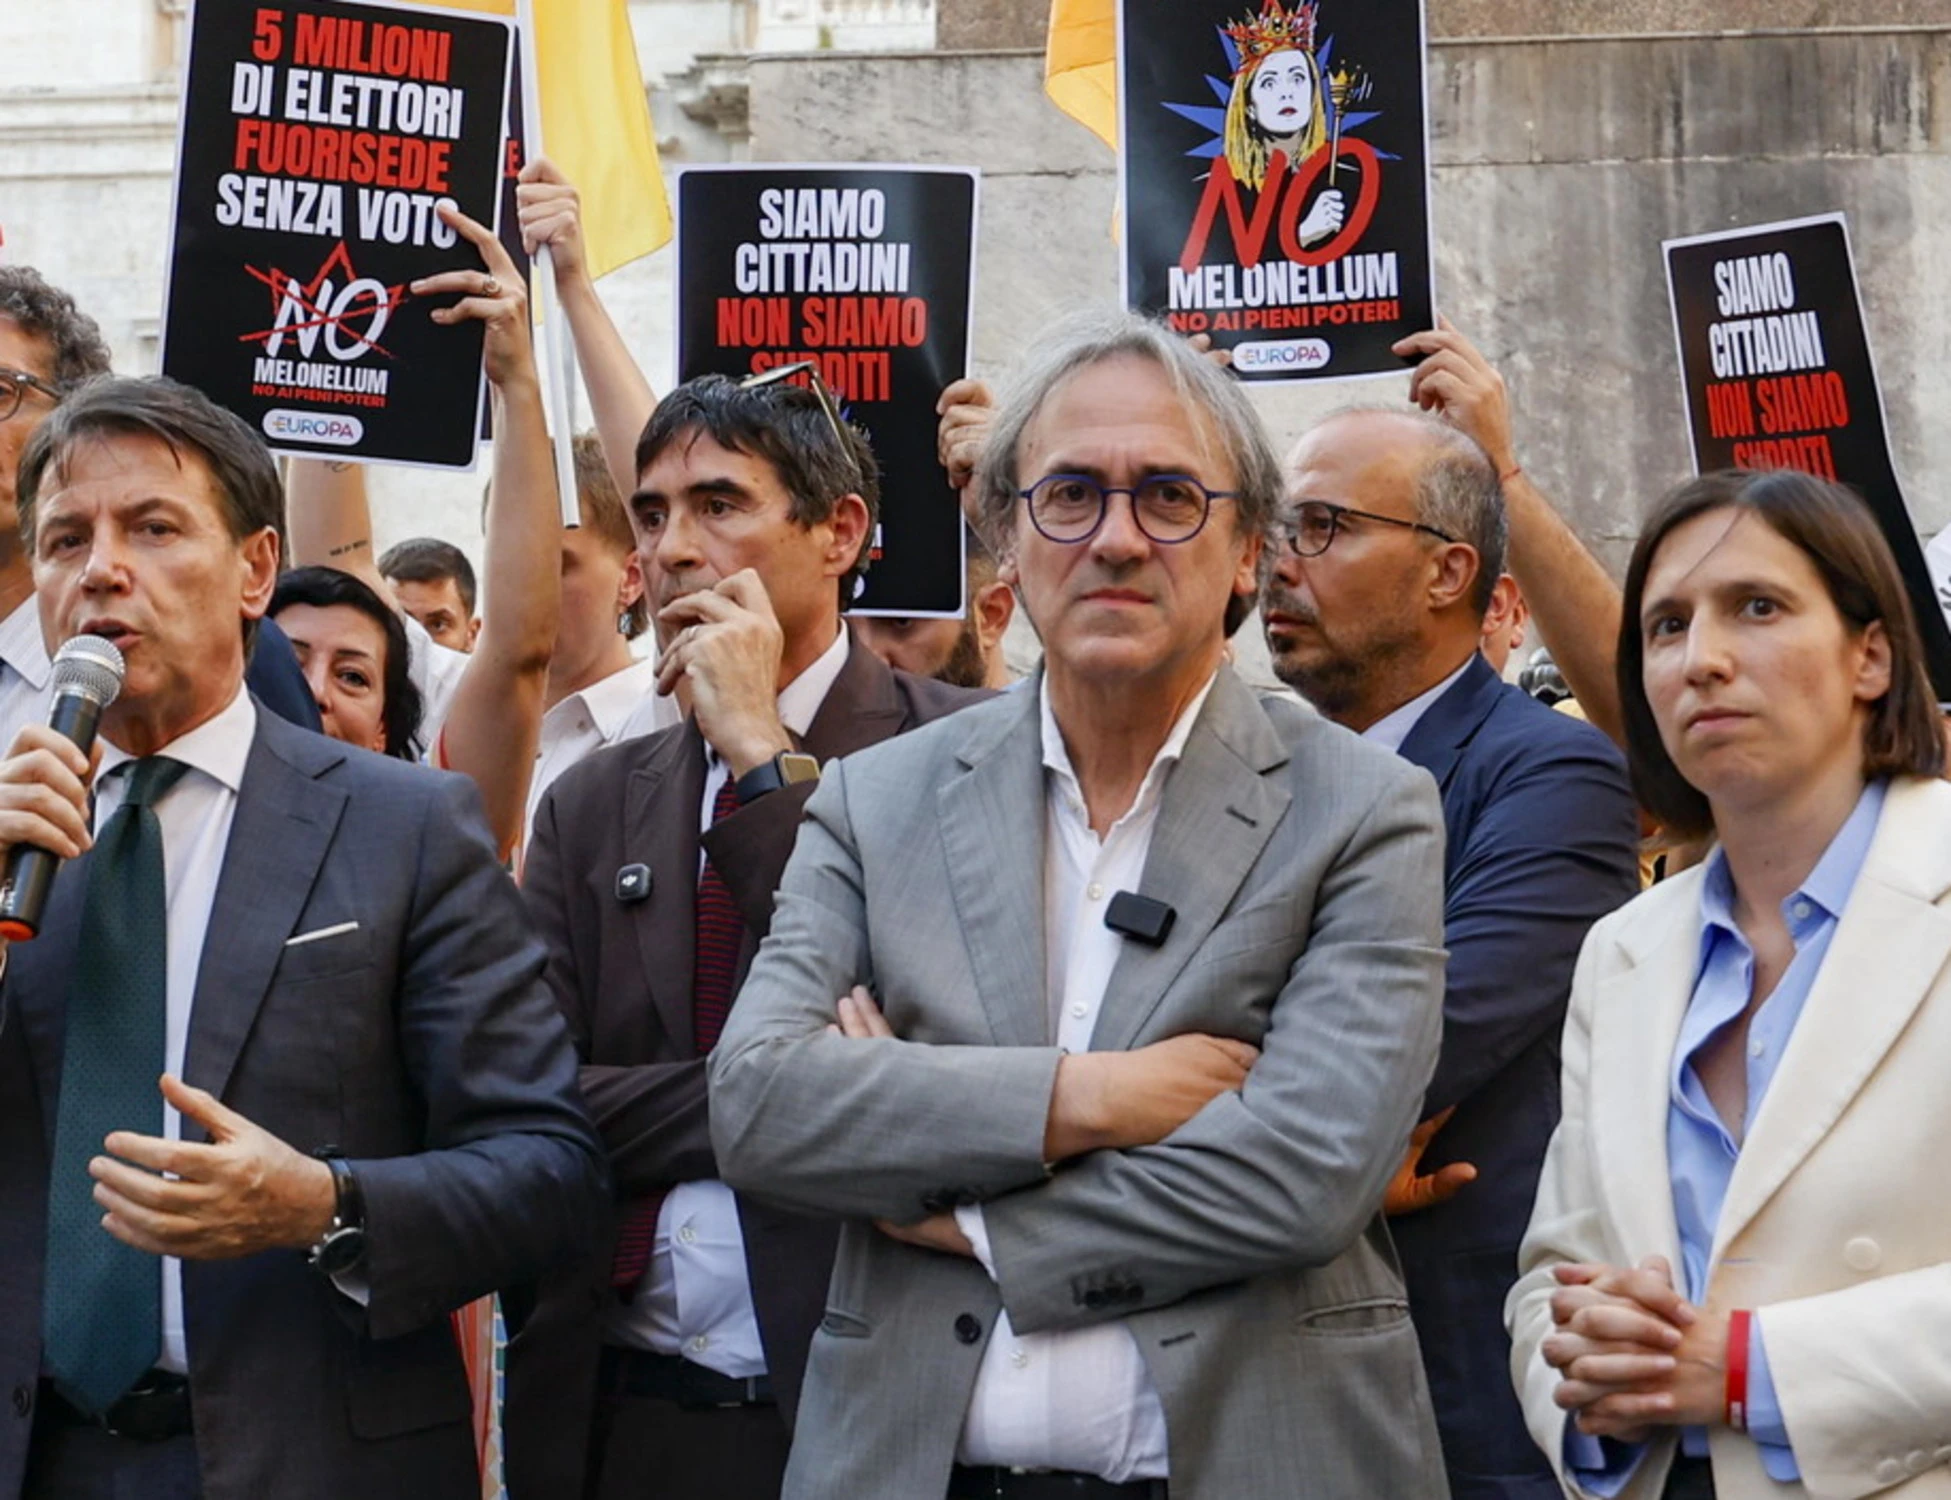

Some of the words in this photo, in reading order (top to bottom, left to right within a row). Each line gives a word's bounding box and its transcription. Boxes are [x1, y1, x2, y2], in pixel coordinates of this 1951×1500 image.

[252, 8, 283, 61] 5
[294, 14, 452, 82] MILIONI
[231, 62, 273, 117] DI
[284, 68, 463, 139] ELETTORI
[234, 119, 452, 192] FUORISEDE
[215, 173, 343, 237] SENZA
[358, 189, 460, 249] VOTO
[759, 188, 885, 239] SIAMO
[1179, 136, 1381, 274] NO
[735, 242, 910, 293] CITTADINI
[1168, 252, 1399, 309] MELONELLUM
[1714, 252, 1795, 316] SIAMO
[266, 278, 388, 360] NO
[717, 297, 793, 347] NON
[802, 297, 927, 347] SIAMO
[1168, 312, 1208, 333] NO
[1213, 311, 1240, 331] AI
[1244, 306, 1309, 330] PIENI
[1313, 300, 1399, 326] POTERI
[1708, 311, 1826, 378] CITTADINI
[252, 384, 275, 396] NO
[277, 387, 293, 399] AI
[295, 388, 332, 403] PIENI
[334, 394, 386, 408] POTERI
[254, 357, 388, 395] MELONELLUM
[1706, 380, 1756, 438] NON
[1756, 371, 1850, 435] SIAMO
